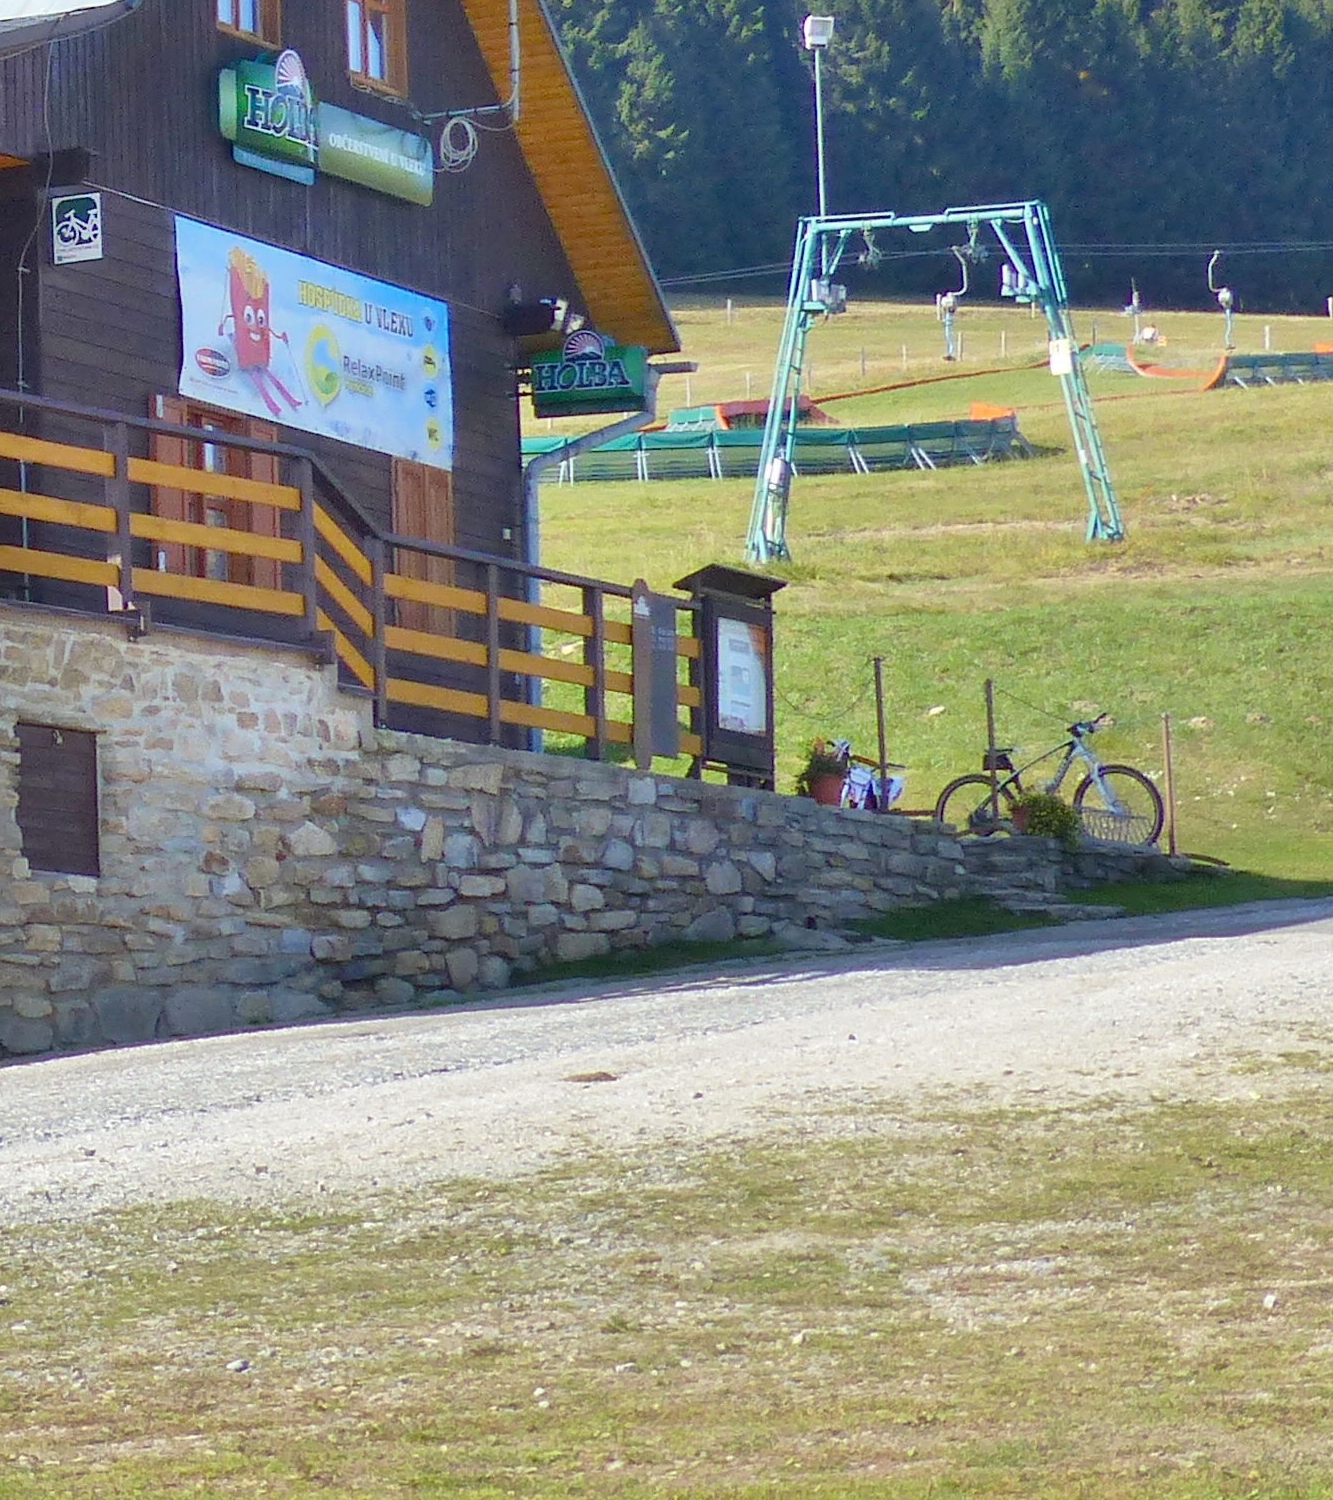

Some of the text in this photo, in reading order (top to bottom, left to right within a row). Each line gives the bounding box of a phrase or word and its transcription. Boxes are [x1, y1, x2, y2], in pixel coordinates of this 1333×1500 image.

[364, 301, 373, 325] U
[375, 307, 415, 339] VLEKU
[342, 355, 406, 391] RelaxPoint
[534, 359, 632, 393] HOLBA
